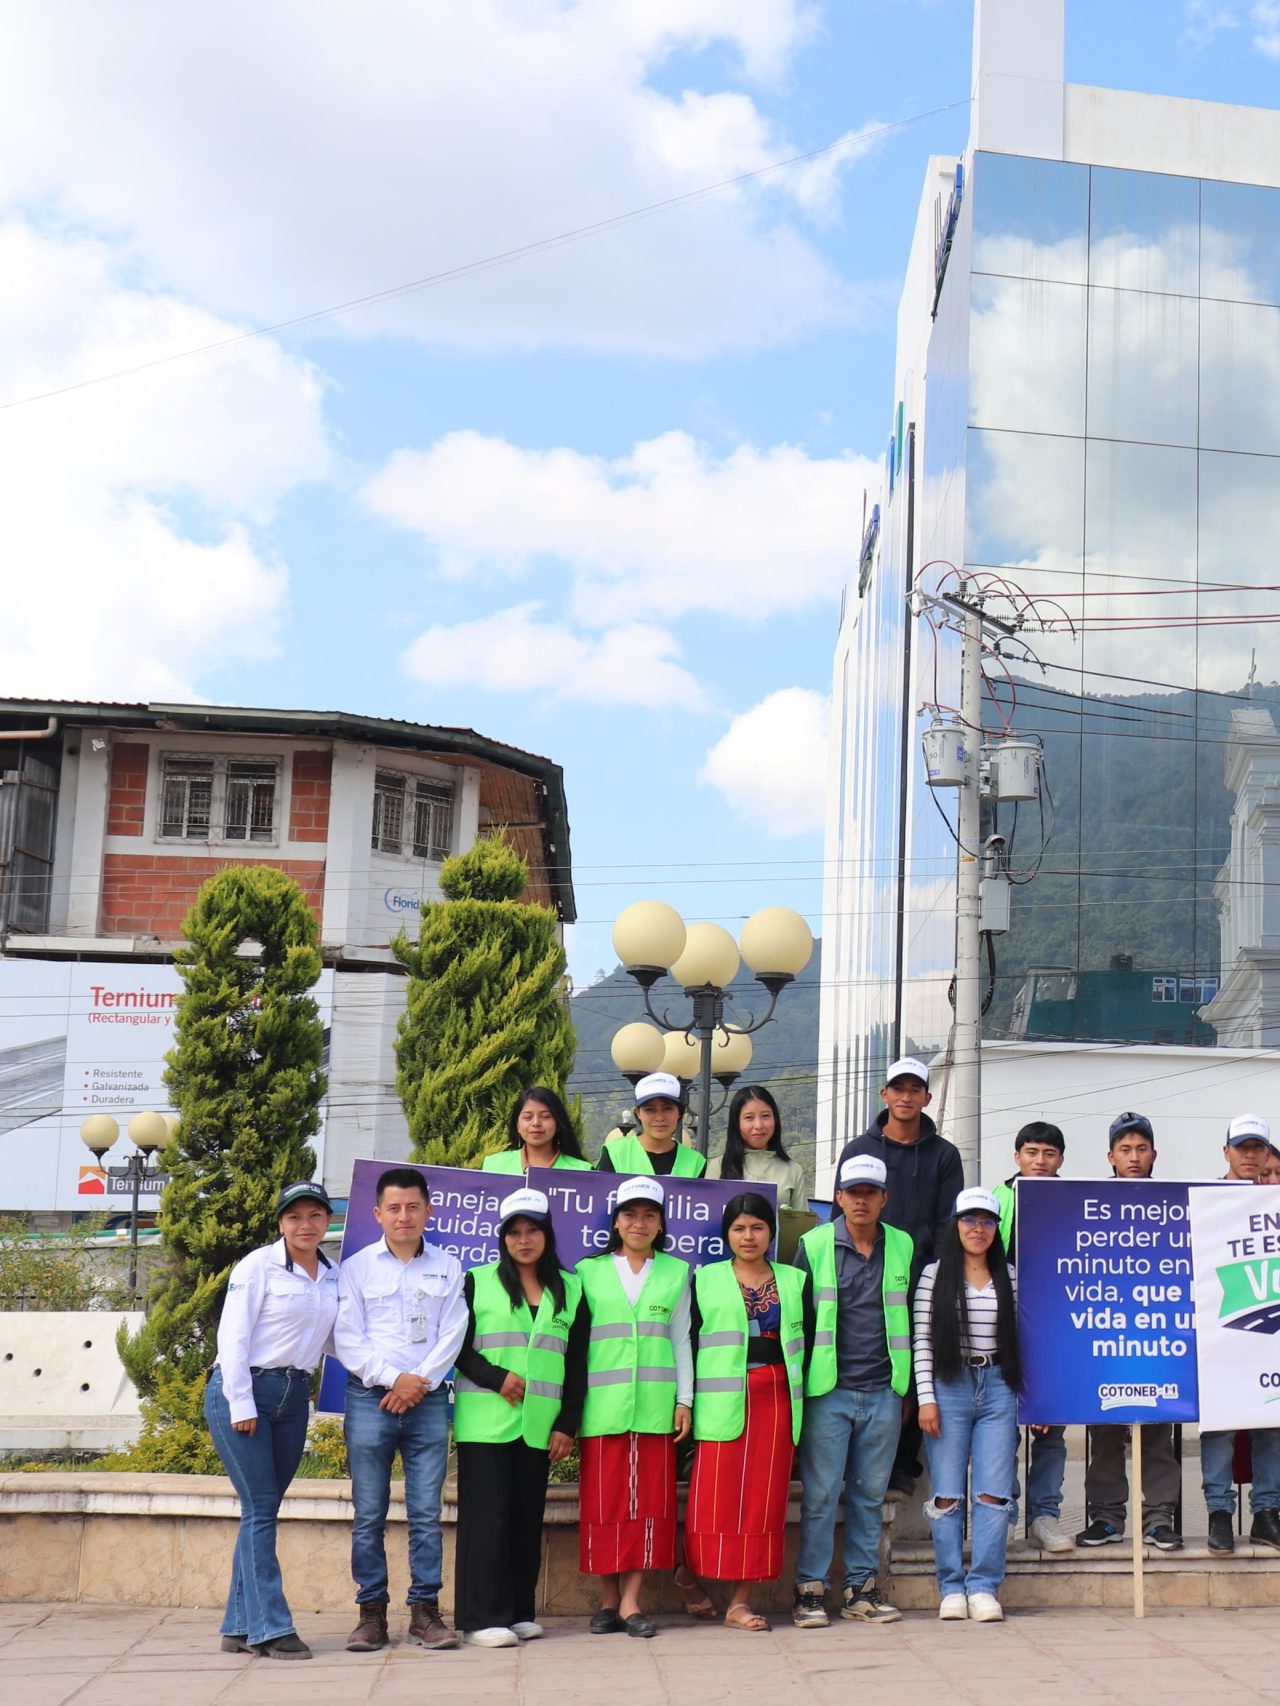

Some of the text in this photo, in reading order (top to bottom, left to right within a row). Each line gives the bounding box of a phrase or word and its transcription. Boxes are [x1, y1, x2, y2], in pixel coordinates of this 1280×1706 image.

[393, 896, 420, 910] Florid
[88, 1012, 171, 1026] (Rectangular y
[93, 1069, 143, 1079] Resistente
[92, 1082, 149, 1092] Galvanizada
[92, 1095, 135, 1104] Duradera
[428, 1187, 499, 1215] aneja
[607, 1191, 709, 1221] filia
[1084, 1199, 1111, 1220] Es
[1249, 1212, 1280, 1233] EN
[1076, 1225, 1160, 1252] perder
[1227, 1237, 1255, 1258] TE
[1057, 1253, 1190, 1275] minuto en
[1065, 1280, 1124, 1303] vida,
[1132, 1284, 1182, 1307] que
[1070, 1307, 1127, 1329] vida
[1134, 1312, 1166, 1329] en
[1092, 1335, 1187, 1357] minuto
[1100, 1385, 1157, 1397] COTONEB
